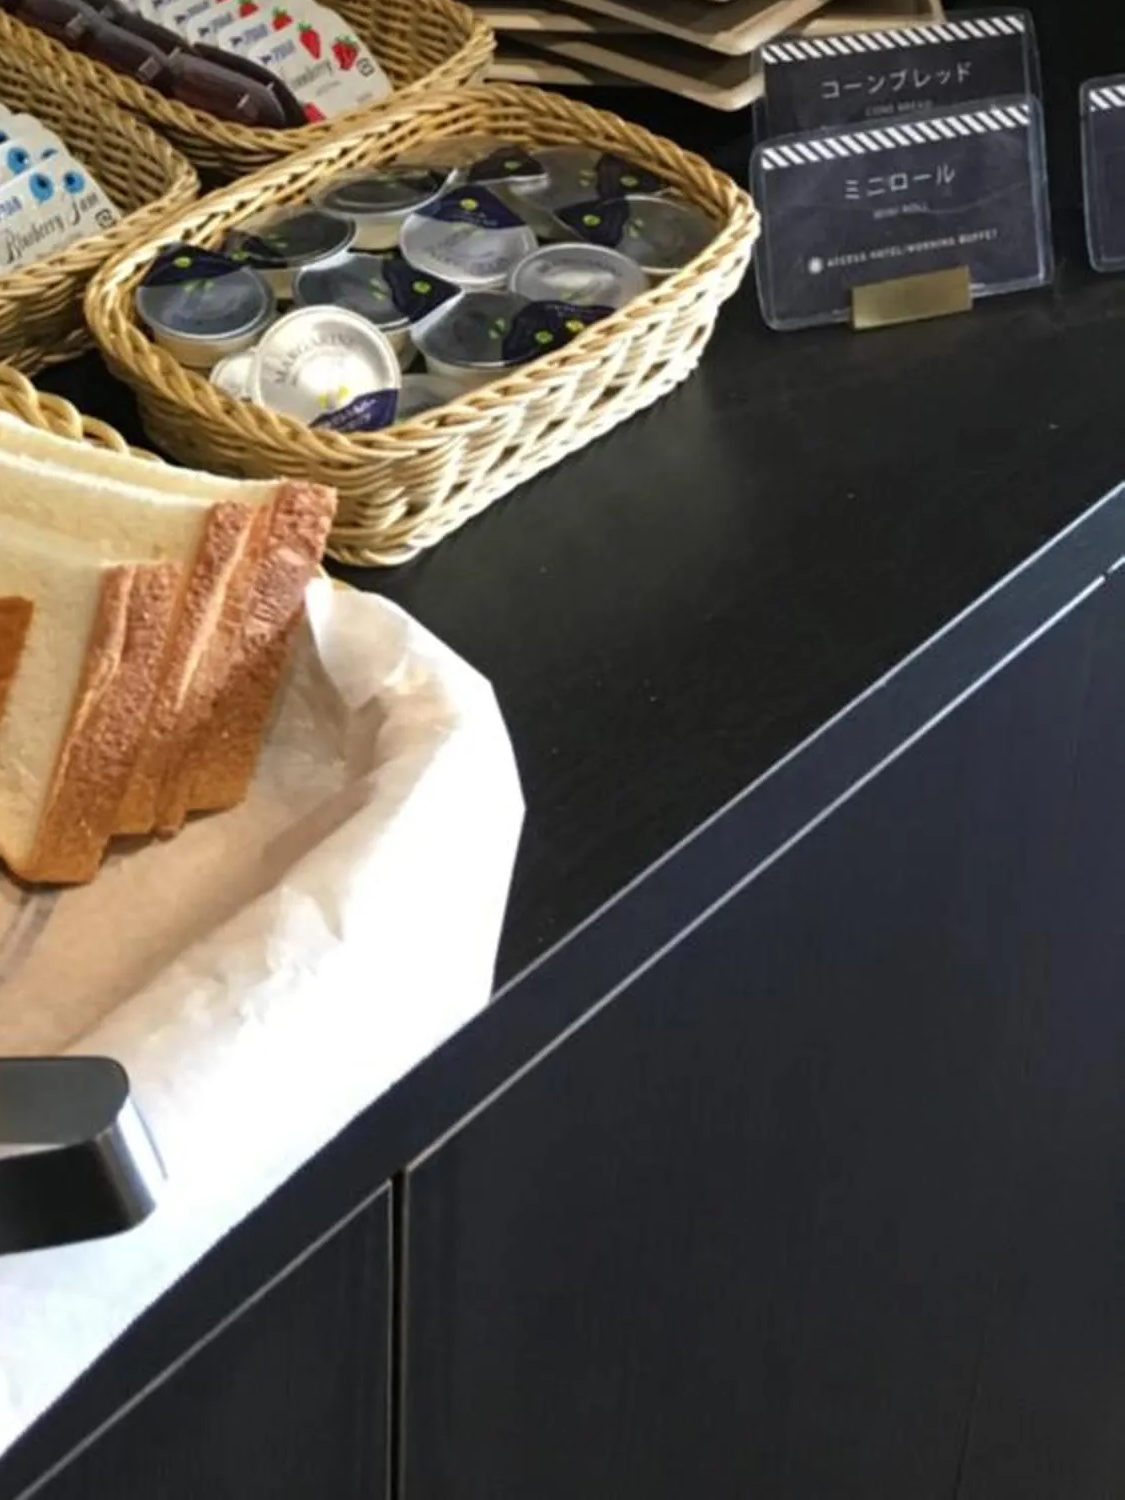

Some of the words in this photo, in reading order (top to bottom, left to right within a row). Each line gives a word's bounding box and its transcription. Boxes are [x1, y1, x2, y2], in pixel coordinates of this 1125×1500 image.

[821, 61, 973, 100] コーンブレッド
[844, 164, 957, 200] ミニロール
